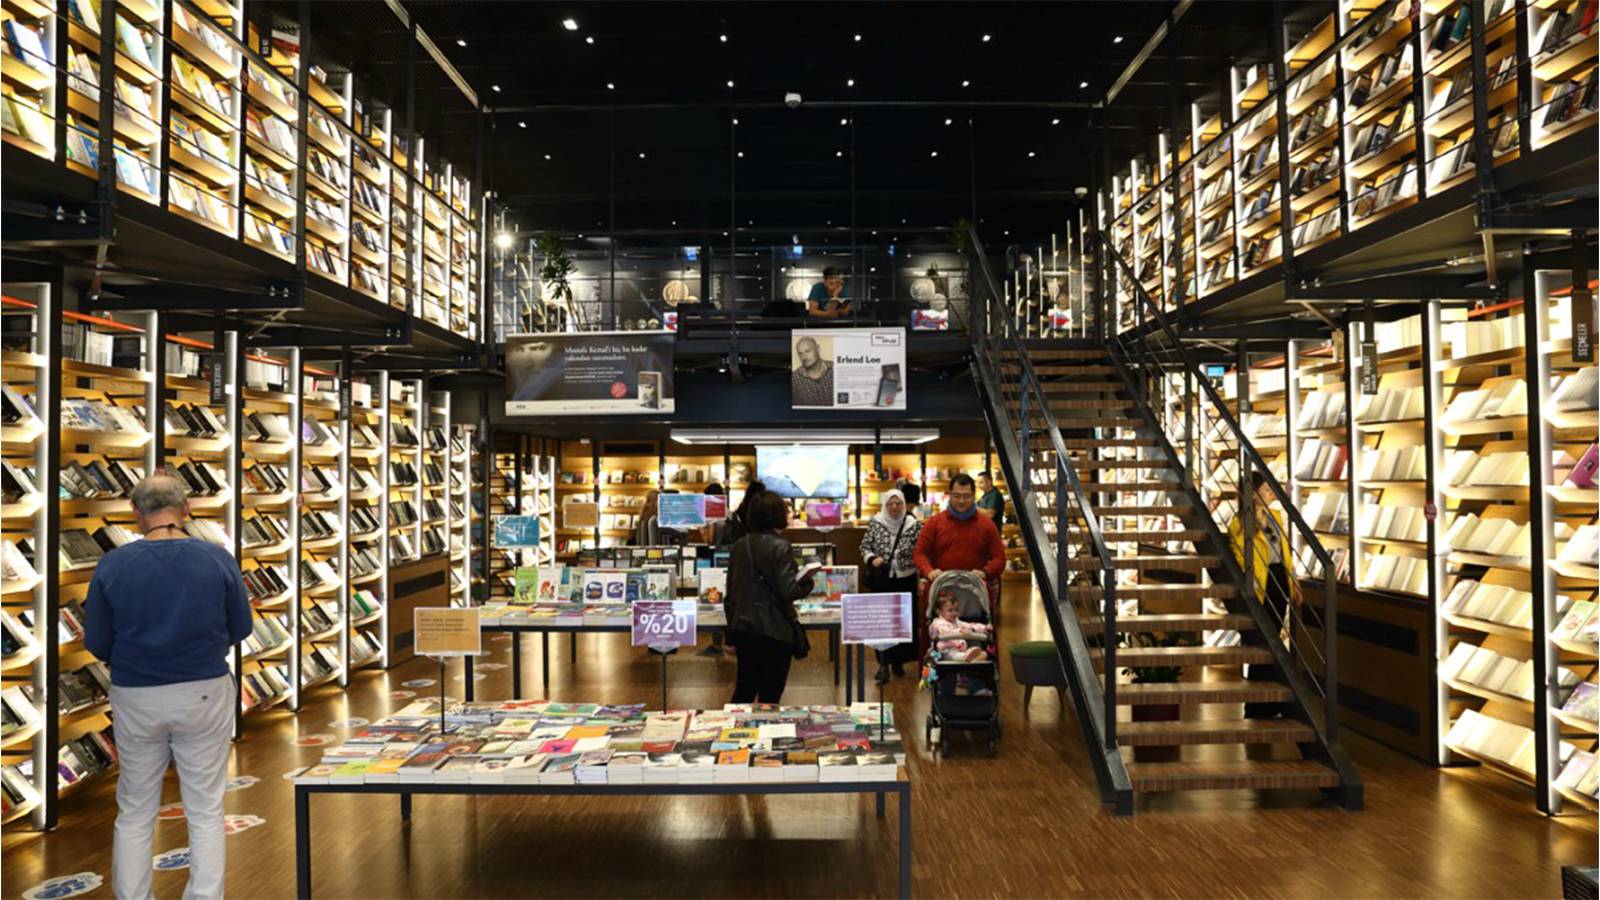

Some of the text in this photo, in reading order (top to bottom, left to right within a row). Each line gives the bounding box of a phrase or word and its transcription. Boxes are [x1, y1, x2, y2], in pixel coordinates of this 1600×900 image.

[1577, 322, 1590, 356] SEÇMELER
[837, 355, 881, 364] Erlend Loe
[640, 613, 688, 634] %20
